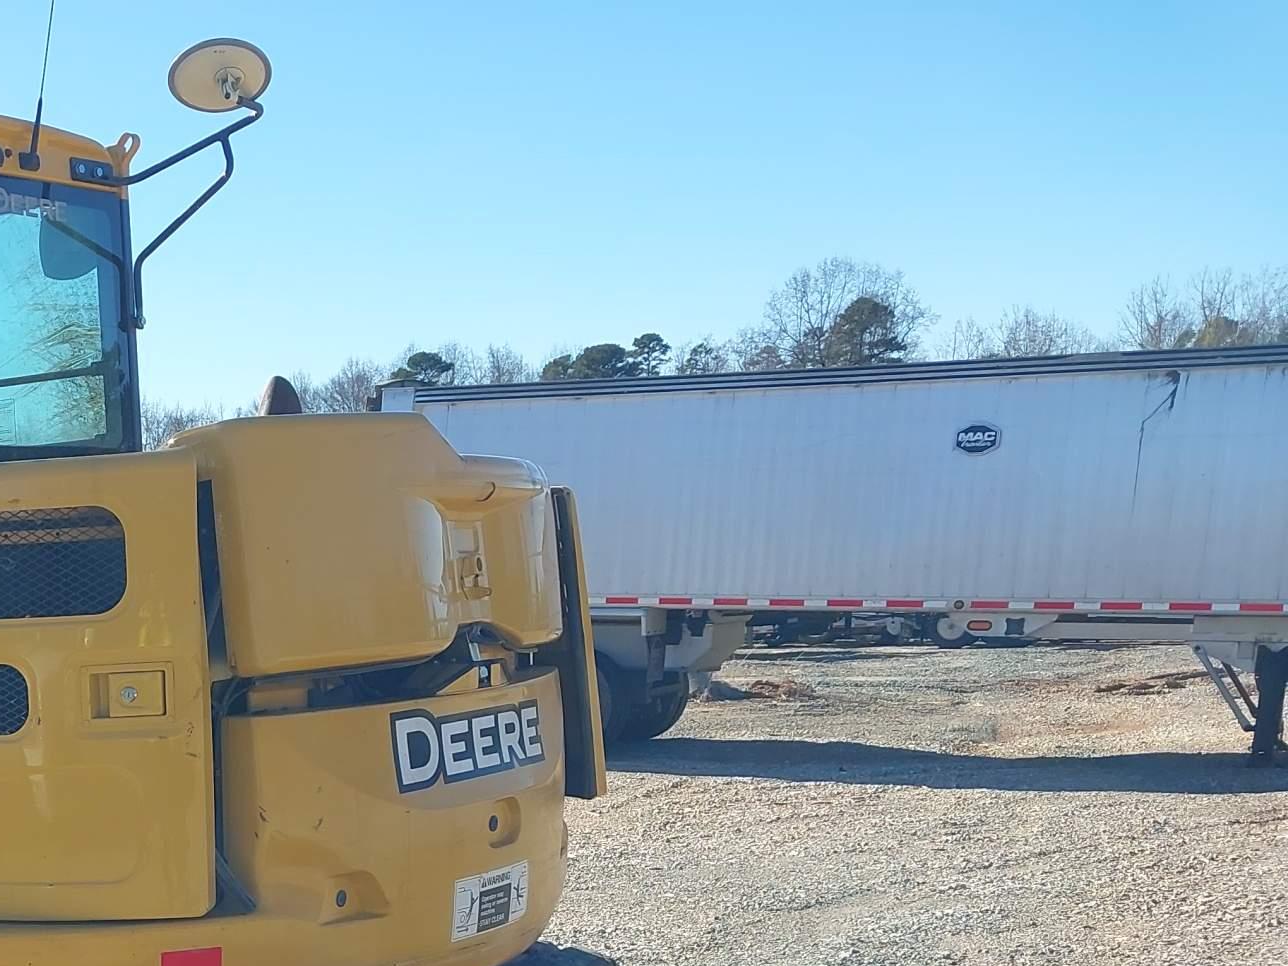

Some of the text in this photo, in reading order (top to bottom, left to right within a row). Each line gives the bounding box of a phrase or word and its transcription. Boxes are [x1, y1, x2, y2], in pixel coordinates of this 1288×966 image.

[958, 431, 996, 441] MAC
[394, 706, 542, 785] DEERE
[487, 871, 511, 886] WARNING
